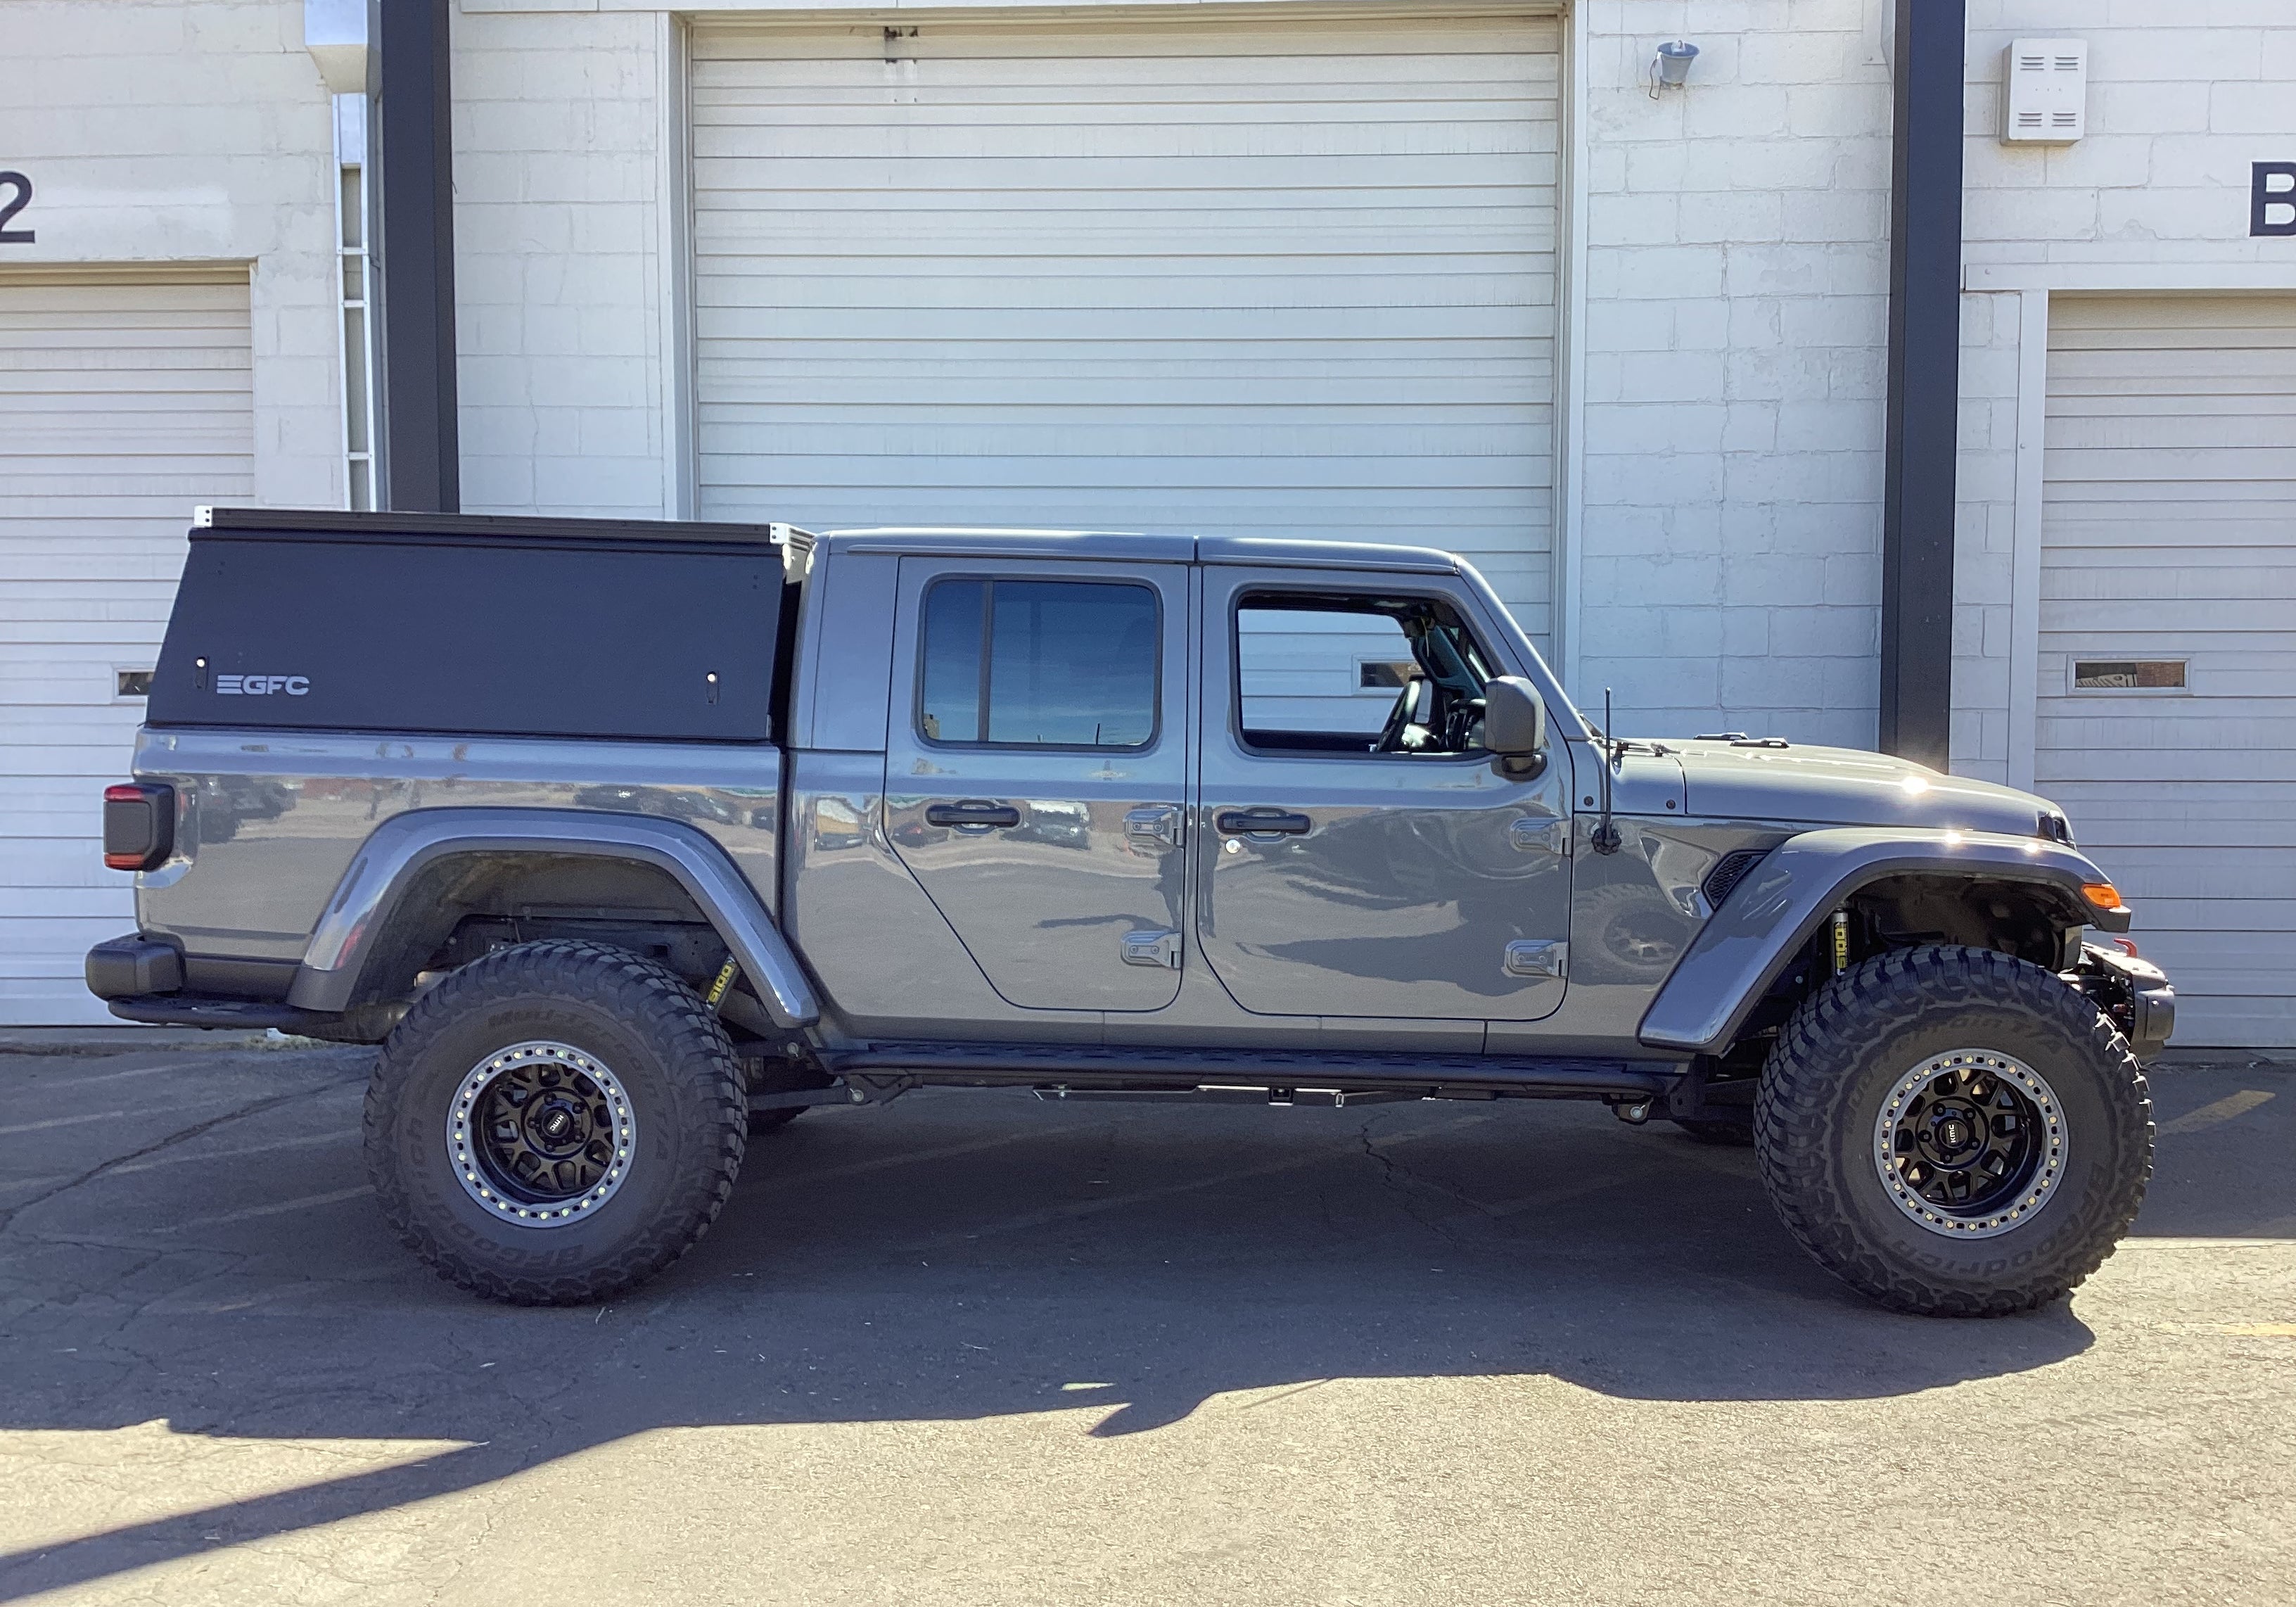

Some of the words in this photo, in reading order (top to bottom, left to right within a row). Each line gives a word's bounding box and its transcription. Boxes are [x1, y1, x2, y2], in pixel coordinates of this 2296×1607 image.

[0, 171, 36, 244] 2
[2249, 161, 2296, 237] B
[1835, 927, 1847, 969] 5100
